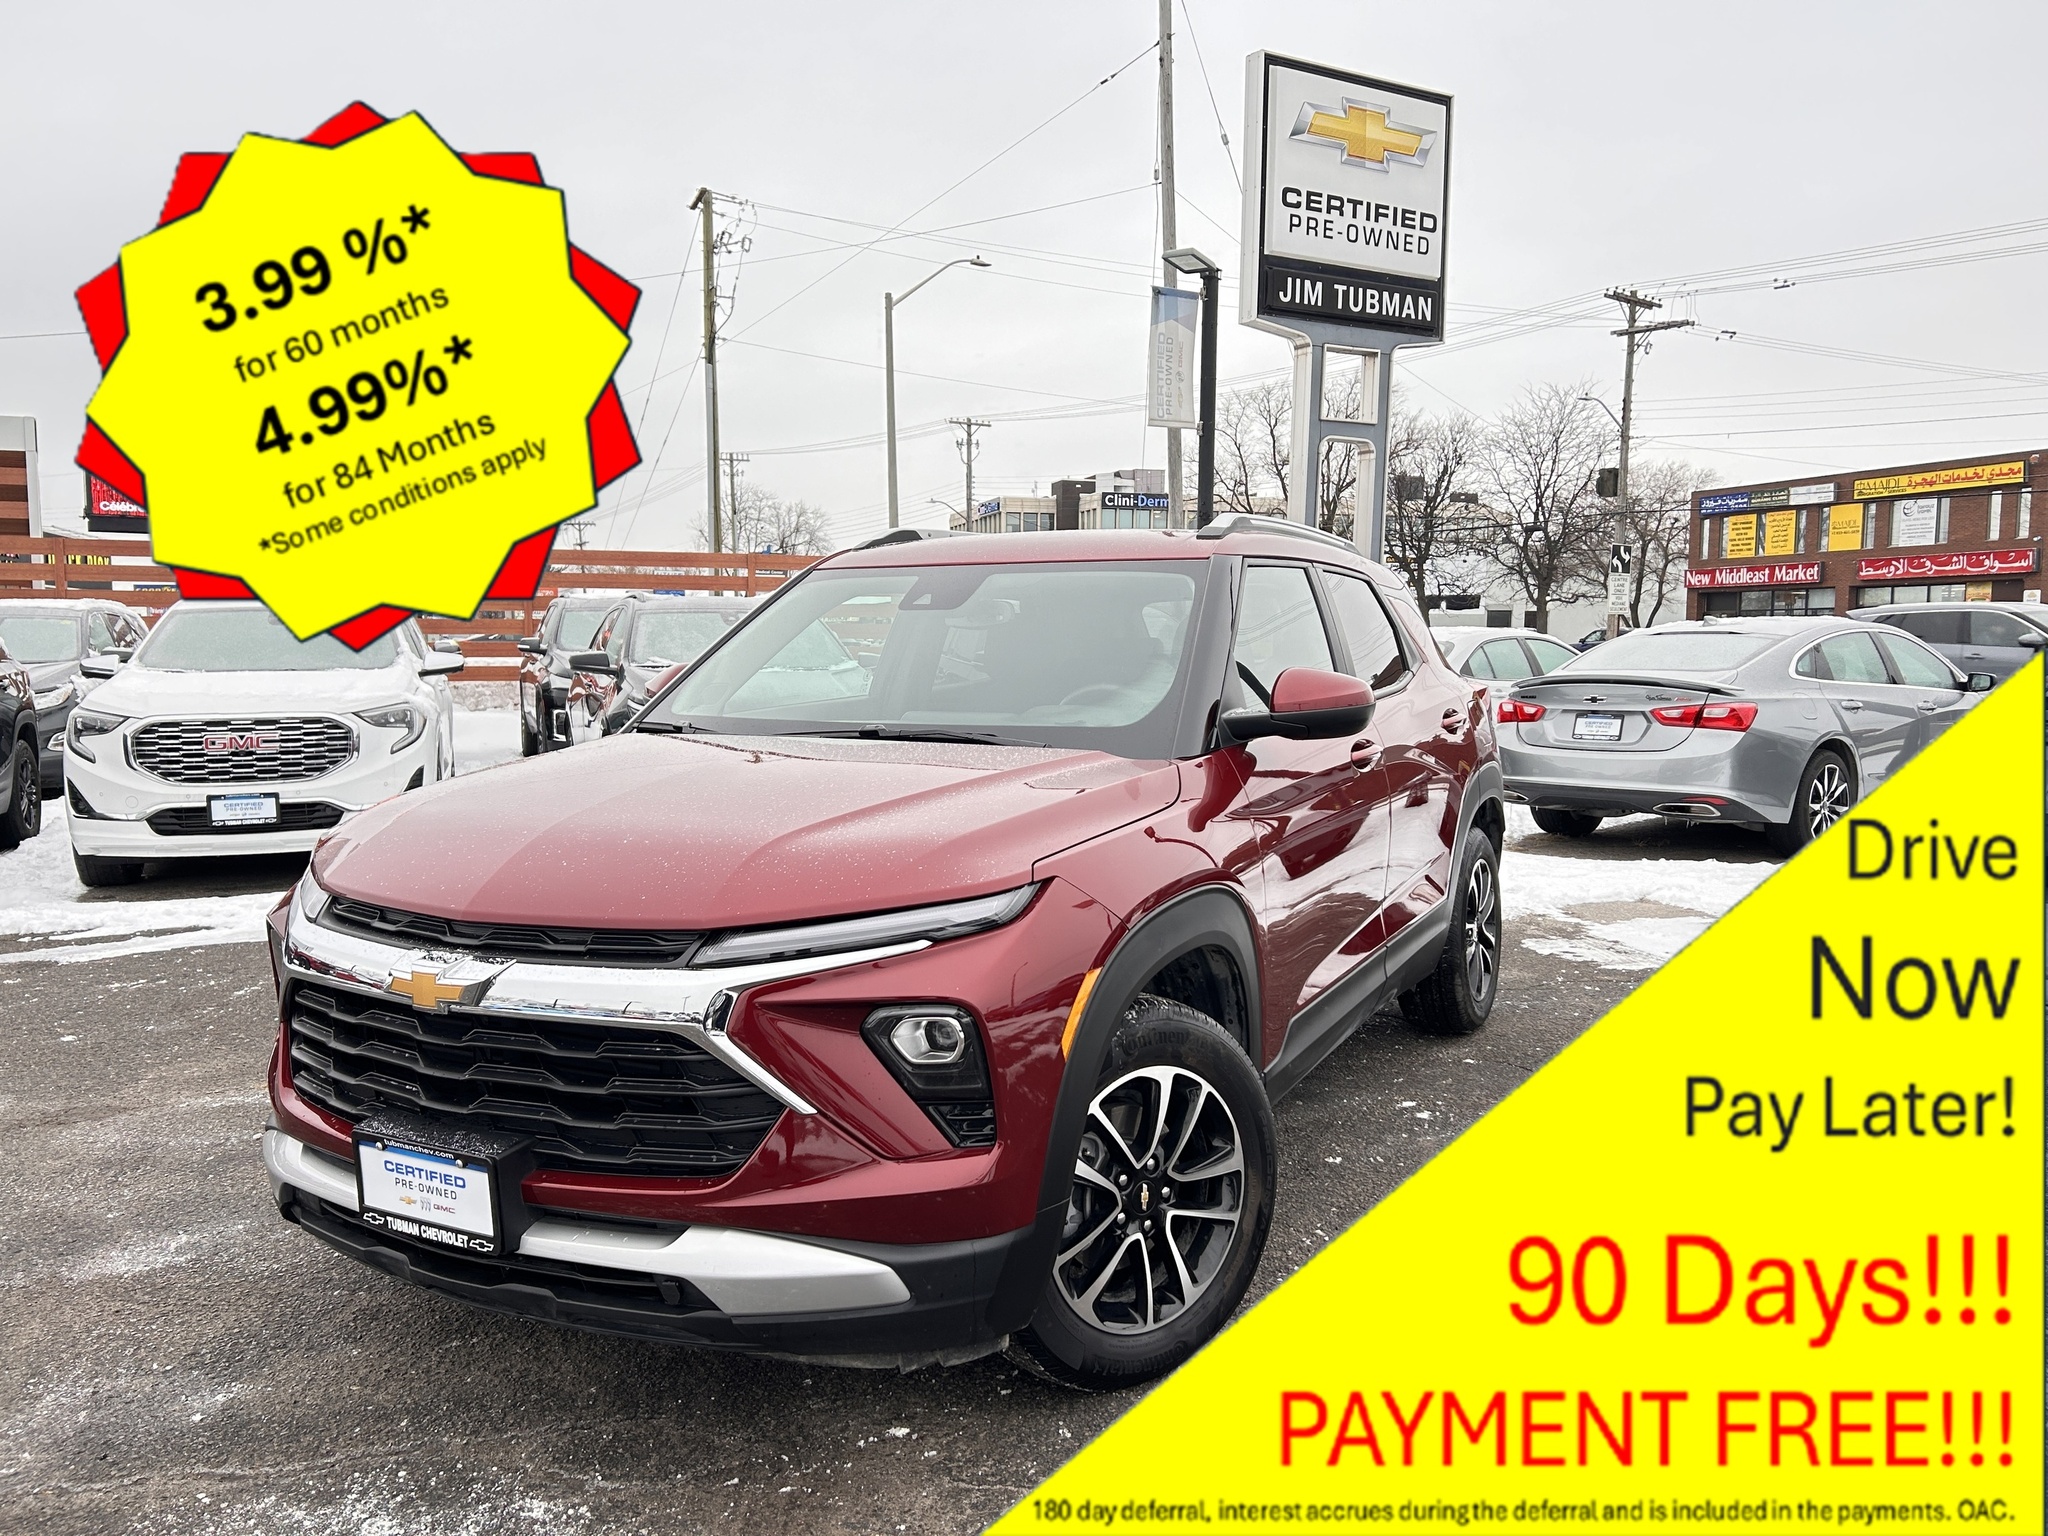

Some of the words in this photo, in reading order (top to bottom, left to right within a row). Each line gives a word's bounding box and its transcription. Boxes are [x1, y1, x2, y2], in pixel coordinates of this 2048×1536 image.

[1281, 187, 1438, 233] CERTIFIED
[1289, 214, 1430, 255] PRE-OWNED
[1279, 277, 1322, 307] JIM
[1334, 284, 1432, 321] TUBMAN
[1156, 332, 1166, 419] CERTIFIED
[1165, 336, 1174, 416] PRE-OWNED
[1686, 570, 1711, 586] New
[1714, 567, 1770, 585] Middleast
[1773, 564, 1819, 582] Market
[203, 733, 281, 752] GMC
[383, 1138, 455, 1159] tubmanchev.com
[384, 1160, 466, 1189] CERTIFIED
[395, 1177, 457, 1200] PRE-OWNED
[433, 1203, 456, 1214] GMC
[386, 1216, 420, 1237] TUBMAN
[420, 1224, 469, 1248] CHEVROLET
